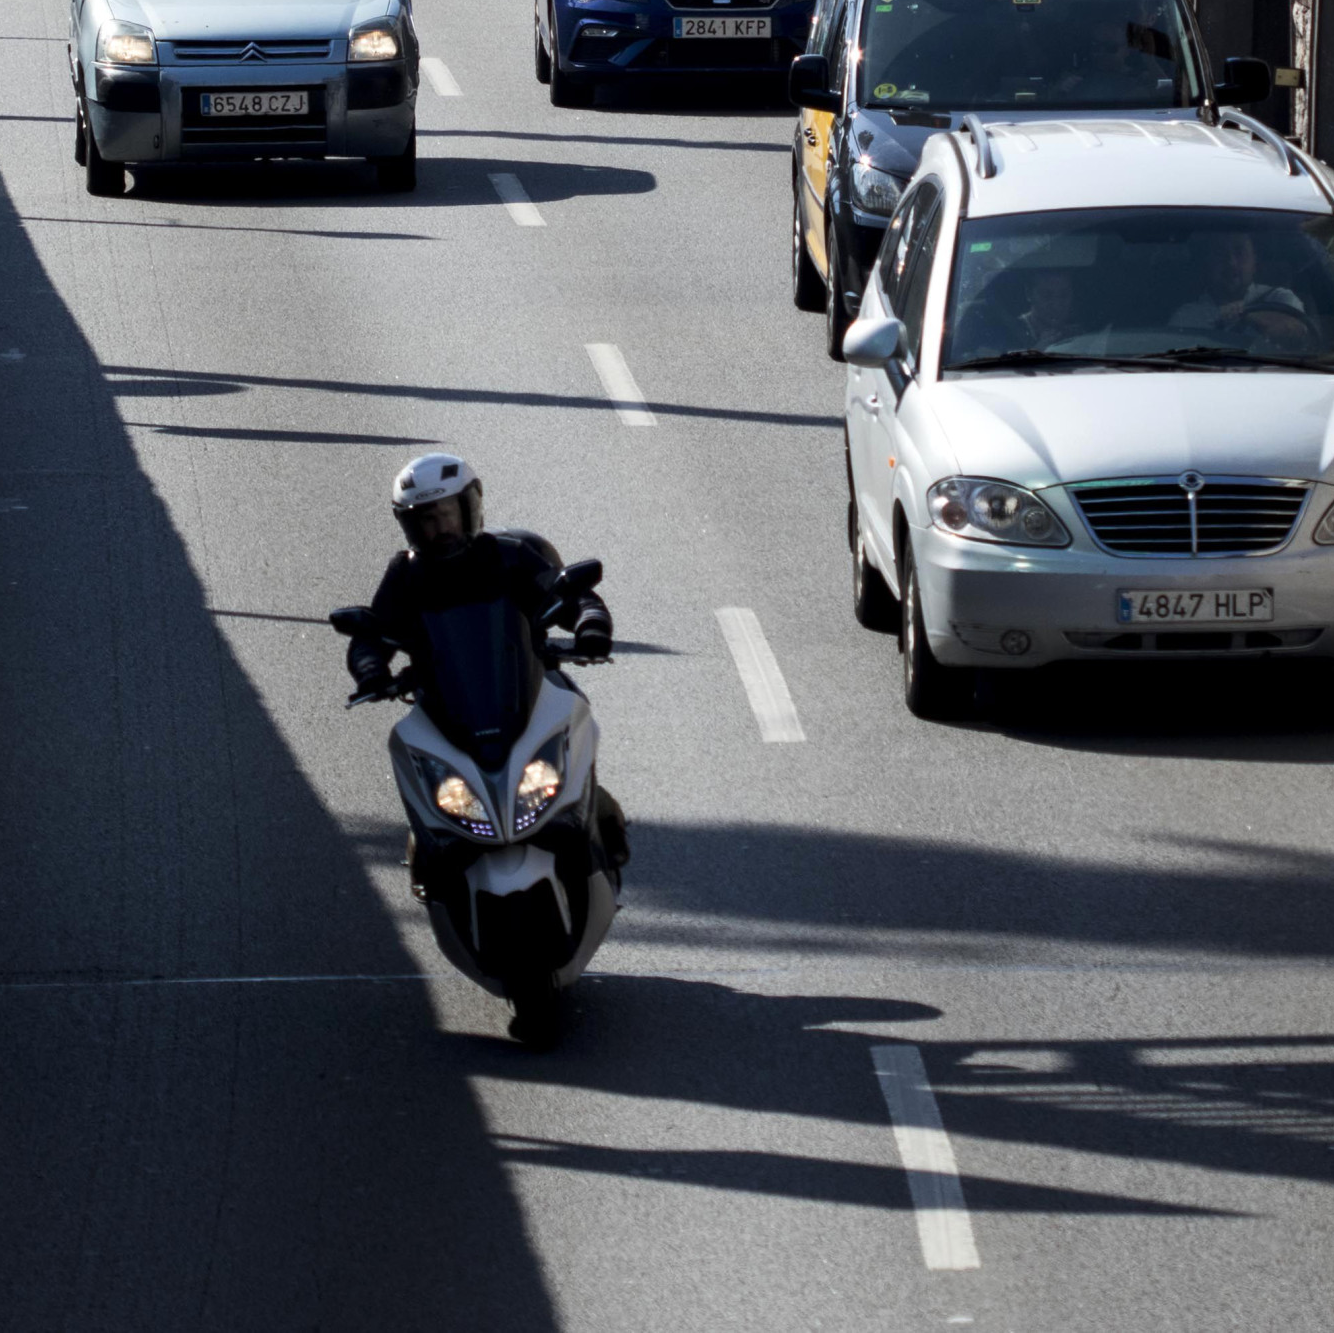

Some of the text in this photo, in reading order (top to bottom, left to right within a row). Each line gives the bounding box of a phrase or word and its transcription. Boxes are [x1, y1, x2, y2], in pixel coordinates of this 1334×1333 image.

[685, 19, 767, 36] 2841 KFP
[213, 94, 304, 113] 6548 CZJ
[1138, 592, 1265, 618] 4847 HLP
